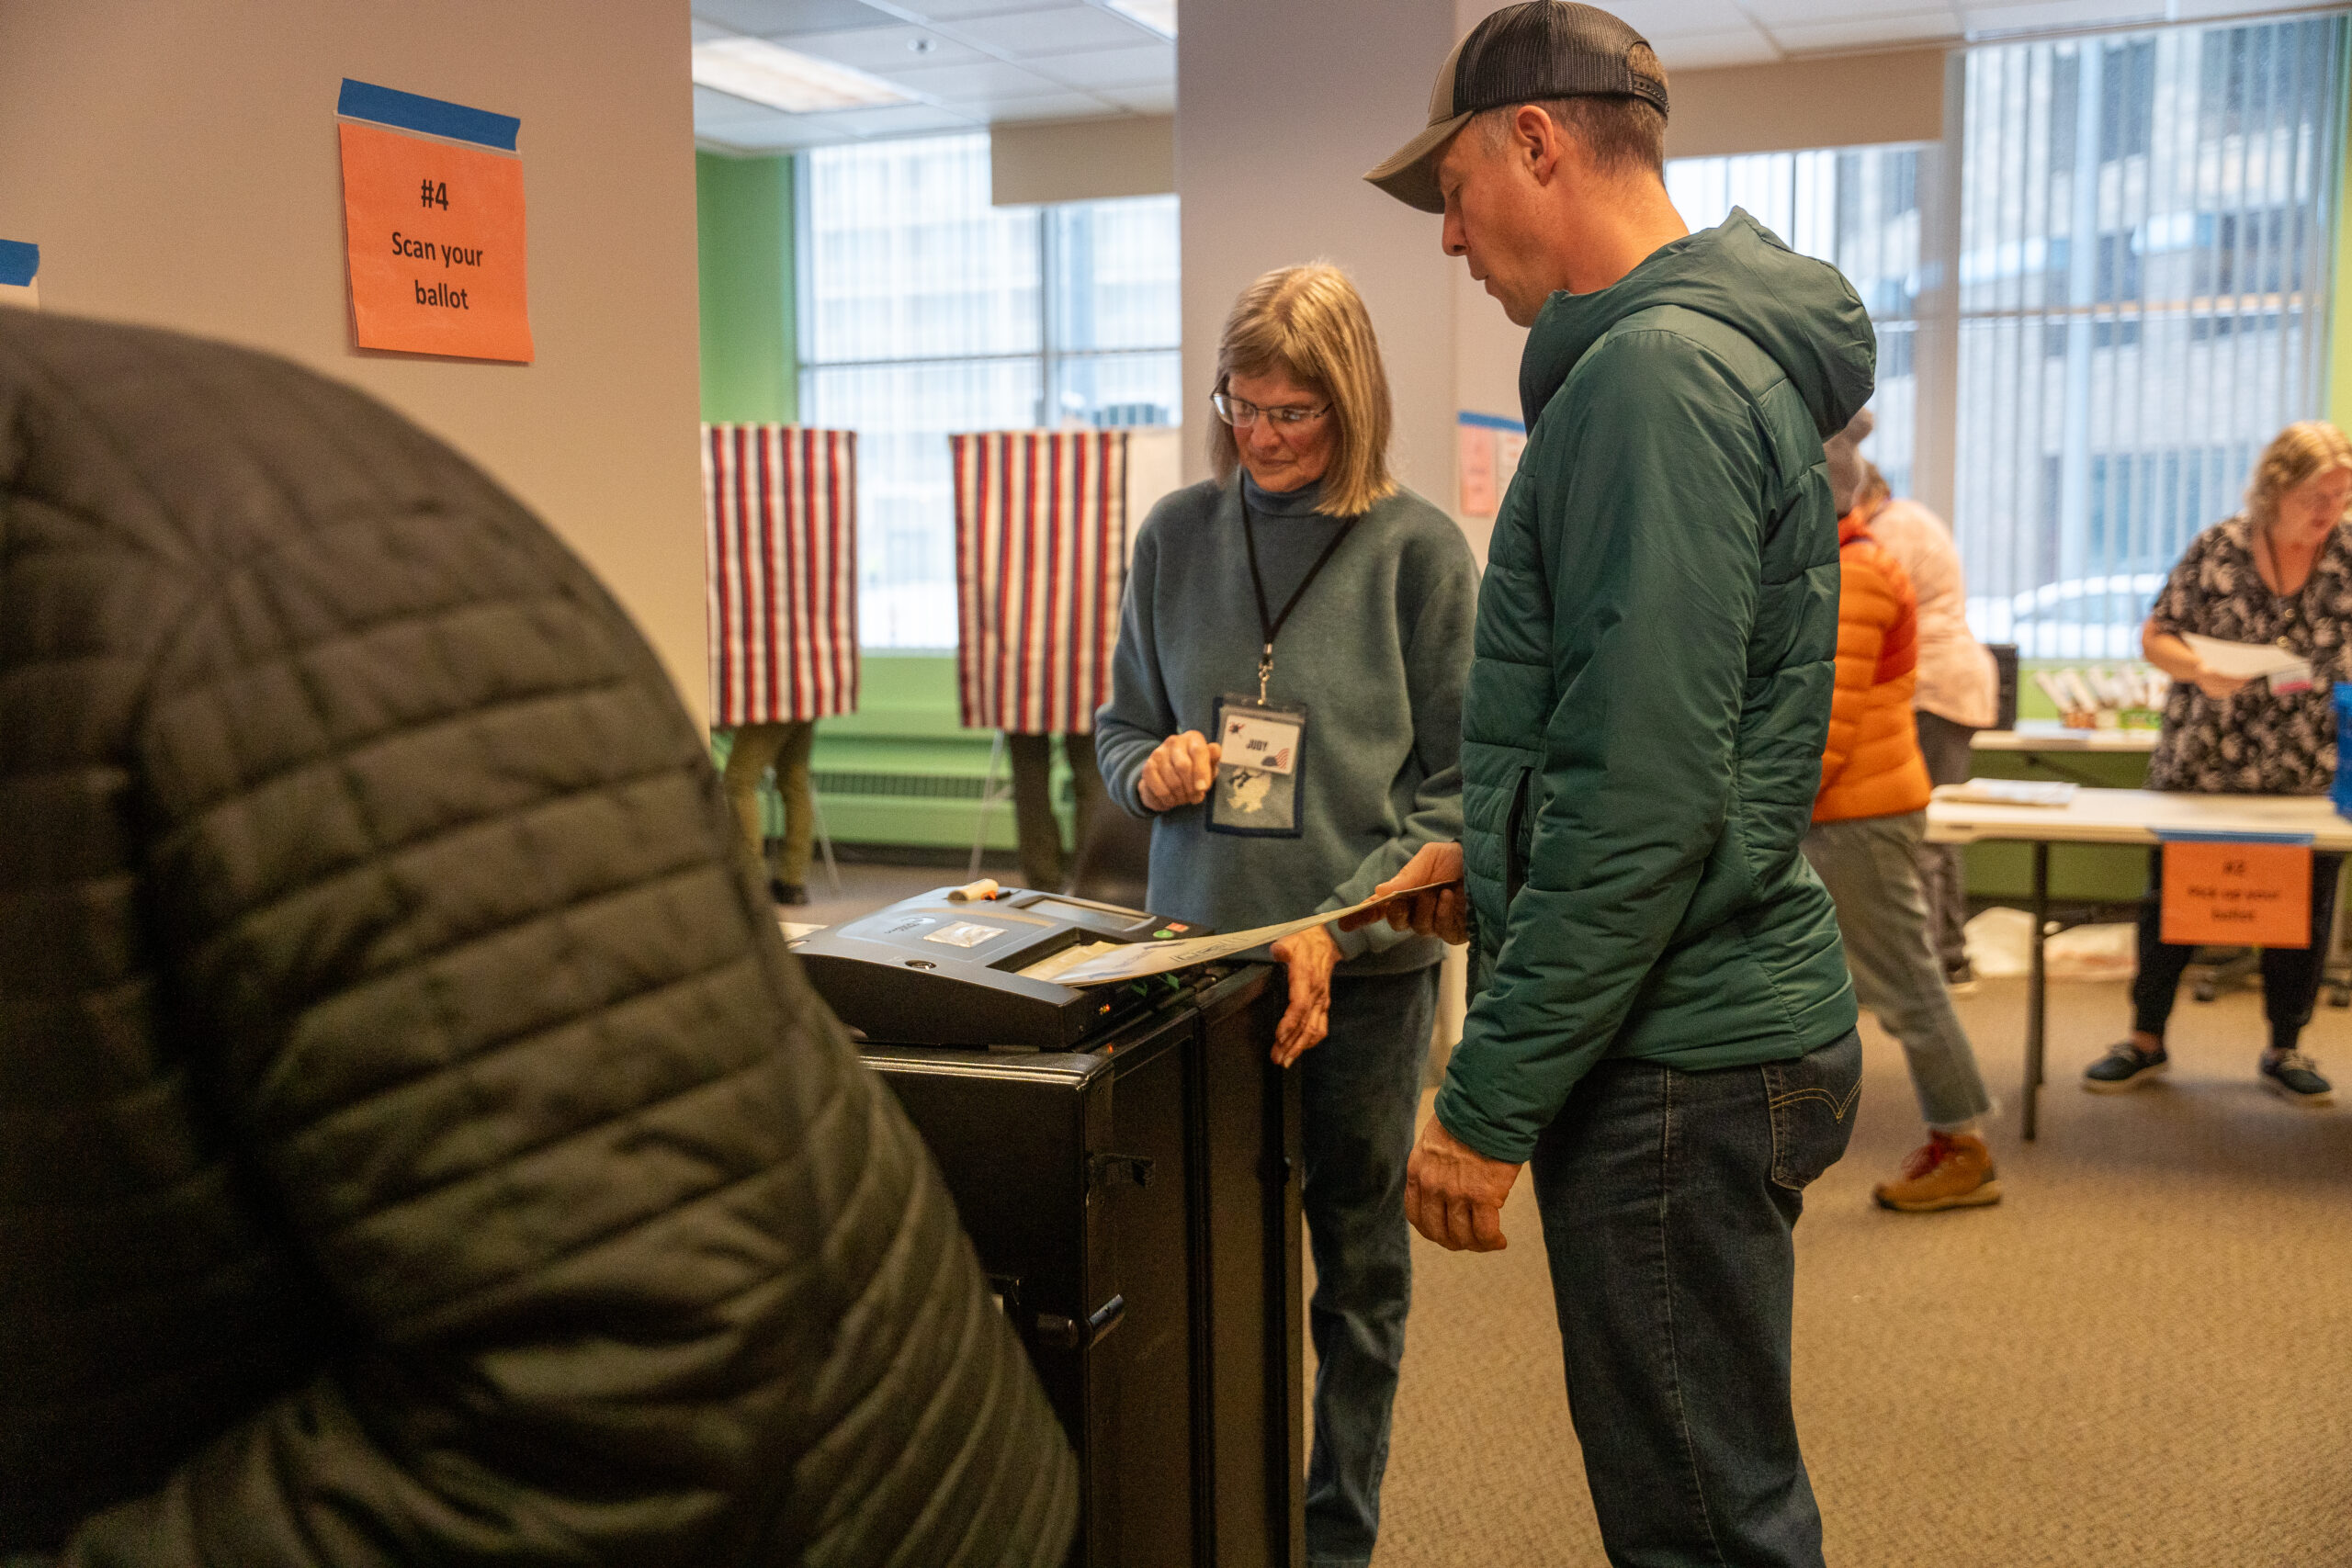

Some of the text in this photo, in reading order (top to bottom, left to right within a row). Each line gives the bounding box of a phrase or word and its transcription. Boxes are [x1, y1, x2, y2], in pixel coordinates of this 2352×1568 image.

[421, 178, 448, 211] #4
[391, 231, 483, 268] Scan your
[414, 279, 469, 310] ballot
[1246, 739, 1268, 752] JUDY
